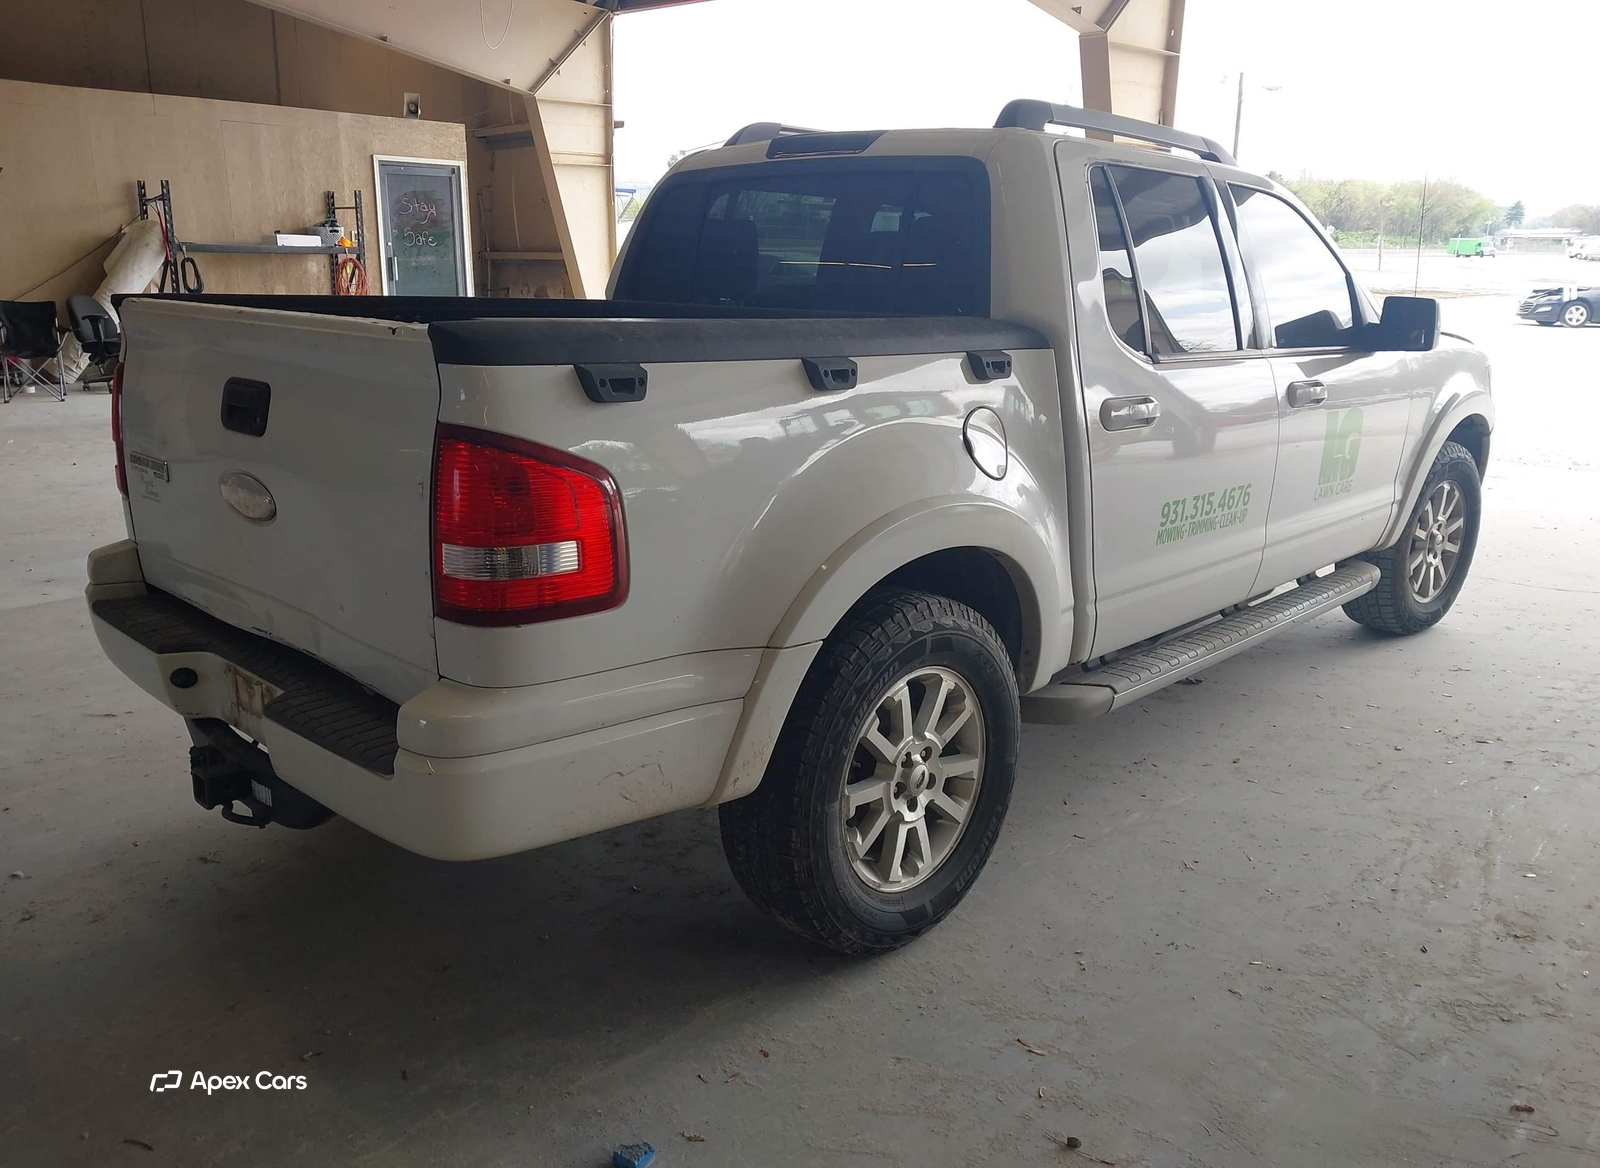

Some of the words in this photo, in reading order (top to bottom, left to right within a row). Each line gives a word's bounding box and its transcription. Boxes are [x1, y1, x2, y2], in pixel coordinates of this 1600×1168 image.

[400, 197, 437, 224] Stay
[403, 227, 437, 247] Safe
[1318, 407, 1364, 486] LG
[1313, 484, 1335, 501] LAWN
[1335, 479, 1354, 496] CARE
[1159, 483, 1252, 528] 931.315.4676
